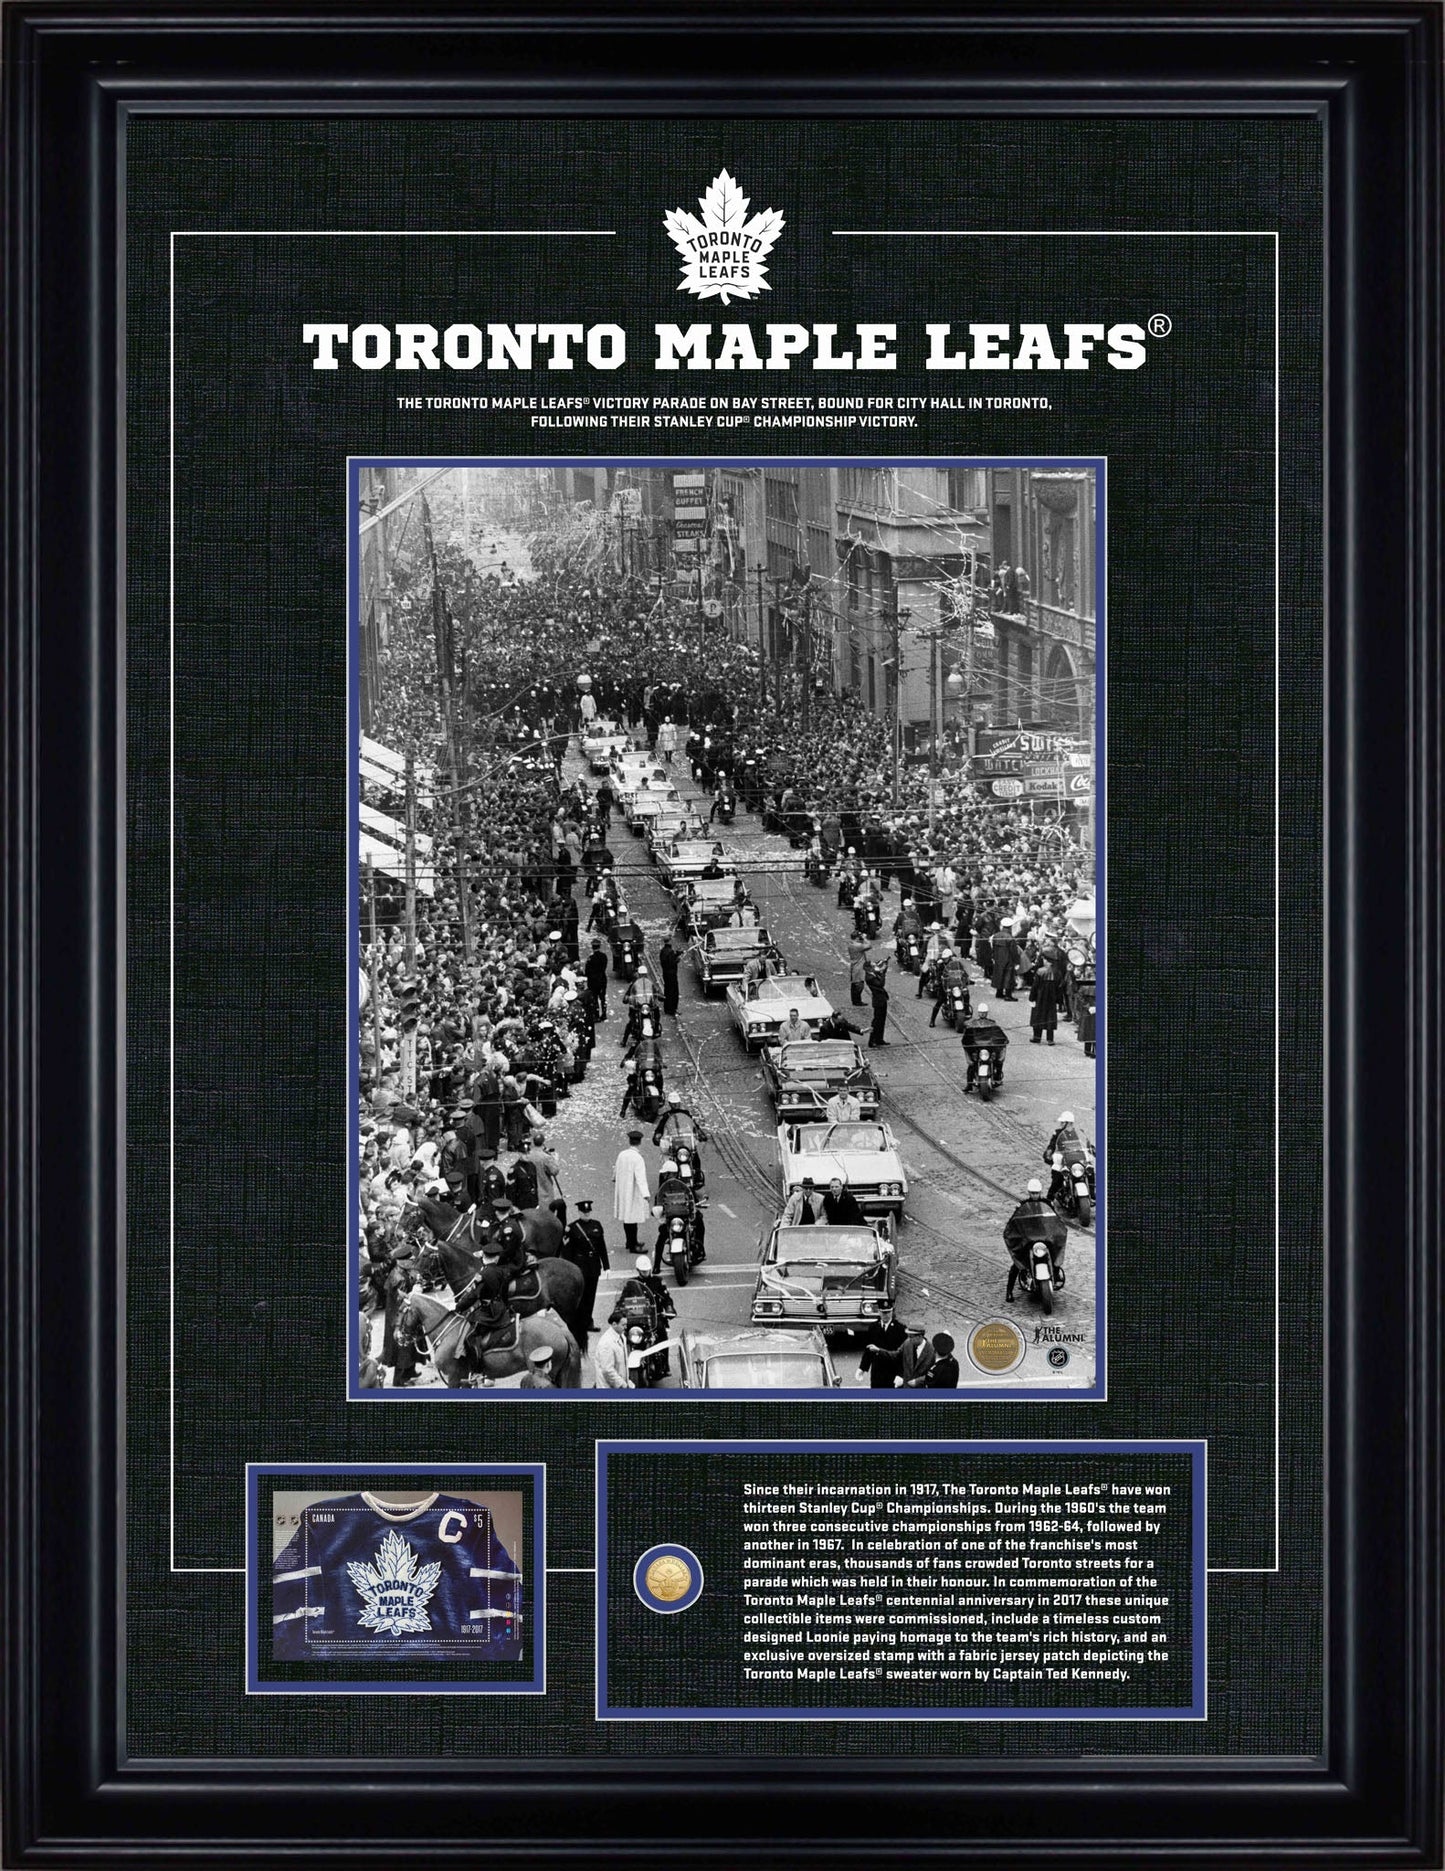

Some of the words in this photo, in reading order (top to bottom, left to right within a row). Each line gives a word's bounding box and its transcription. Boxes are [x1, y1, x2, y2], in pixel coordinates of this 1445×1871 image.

[686, 231, 763, 253] TORONTO
[699, 250, 750, 264] MAPLE
[699, 266, 750, 278] LEAFS
[302, 323, 626, 370] TORONTO
[654, 323, 897, 370] MAPLE
[396, 397, 423, 409] THE
[425, 397, 488, 409] TORONTO
[491, 397, 538, 409] MAPLE
[592, 397, 650, 409] VICTORY
[652, 397, 707, 409] PARADE
[710, 397, 729, 409] ON
[732, 397, 758, 409] BAY
[761, 397, 815, 411] STREET,
[818, 397, 864, 409] BOUND
[867, 397, 894, 409] FOR
[897, 397, 928, 409] CITY
[930, 397, 966, 409] HALL
[968, 397, 983, 409] IN
[985, 397, 1052, 411] TORONTO,
[531, 415, 608, 428] FOLLOWING
[610, 415, 650, 428] THEIR
[654, 415, 714, 428] STANLEY
[753, 415, 857, 428] CHAMPIONSHIP
[858, 415, 918, 428] VICTORY.
[1029, 782, 1058, 791] Kodak
[743, 1483, 780, 1495] Since
[782, 1483, 814, 1495] their
[817, 1483, 892, 1496] incarnation
[895, 1483, 907, 1495] in
[909, 1483, 940, 1497] 1917,
[941, 1483, 966, 1495] The
[968, 1483, 1019, 1495] Toronto
[1022, 1483, 1062, 1498] Maple
[1111, 1483, 1142, 1496] have
[1144, 1486, 1171, 1496] won
[743, 1501, 796, 1514] thirteen
[799, 1501, 848, 1517] Stanley
[886, 1501, 991, 1517] Championships.
[994, 1501, 1037, 1517] During
[1039, 1501, 1062, 1514] the
[1064, 1501, 1106, 1514] 1960's
[1108, 1501, 1130, 1514] the
[1132, 1502, 1167, 1514] team
[312, 1513, 335, 1524] CANADA
[473, 1514, 484, 1529] $5
[438, 1510, 468, 1544] C
[743, 1523, 770, 1532] won
[772, 1520, 807, 1532] three
[810, 1519, 889, 1532] consecutive
[892, 1519, 992, 1535] championships
[994, 1520, 1026, 1532] from
[1028, 1520, 1084, 1534] 1962-64,
[1086, 1520, 1142, 1532] followed
[1145, 1520, 1161, 1535] by
[743, 1538, 795, 1551] another
[797, 1538, 810, 1551] in
[812, 1538, 845, 1551] 1967.
[851, 1538, 864, 1551] In
[867, 1538, 941, 1551] celebration
[944, 1538, 959, 1551] of
[961, 1541, 985, 1551] one
[988, 1538, 1003, 1550] of
[1004, 1538, 1027, 1551] the
[1029, 1538, 1102, 1551] franchise's
[1104, 1539, 1138, 1551] most
[743, 1556, 806, 1569] dominant
[808, 1559, 841, 1571] eras,
[843, 1557, 913, 1569] thousands
[916, 1557, 931, 1569] of
[932, 1556, 962, 1569] fans
[964, 1557, 1019, 1569] crowded
[1021, 1557, 1072, 1569] Toronto
[1075, 1558, 1122, 1569] streets
[1124, 1556, 1144, 1569] for
[1146, 1559, 1154, 1569] a
[367, 1580, 425, 1596] TORONTO
[743, 1575, 789, 1590] parade
[791, 1575, 829, 1588] which
[831, 1578, 857, 1588] was
[860, 1575, 888, 1588] held
[891, 1575, 904, 1588] in
[906, 1575, 938, 1588] their
[940, 1575, 990, 1588] honour.
[993, 1575, 1006, 1588] In
[1009, 1575, 1116, 1588] commemoration
[1119, 1575, 1134, 1588] of
[1135, 1575, 1158, 1588] the
[378, 1596, 414, 1607] MAPLE
[743, 1593, 794, 1606] Toronto
[796, 1594, 836, 1609] Maple
[886, 1593, 955, 1606] centennial
[958, 1593, 1035, 1609] anniversary
[1037, 1593, 1050, 1606] in
[1053, 1593, 1083, 1606] 2017
[1084, 1593, 1122, 1606] these
[1124, 1593, 1169, 1609] unique
[377, 1606, 417, 1618] LEAFS
[743, 1612, 812, 1624] collectible
[815, 1612, 852, 1625] items
[854, 1615, 886, 1625] were
[888, 1612, 988, 1626] commissioned,
[991, 1612, 1039, 1625] include
[1042, 1615, 1050, 1625] a
[1052, 1612, 1110, 1625] timeless
[1112, 1613, 1162, 1625] custom
[460, 1624, 484, 1634] 1917-2017
[743, 1630, 803, 1646] designed
[806, 1630, 850, 1643] Loonie
[853, 1630, 897, 1646] paying
[899, 1630, 952, 1646] homage
[954, 1632, 969, 1643] to
[970, 1630, 993, 1643] the
[995, 1631, 1040, 1643] team's
[1043, 1630, 1068, 1643] rich
[1071, 1630, 1120, 1646] history,
[1123, 1630, 1148, 1643] and
[1151, 1633, 1167, 1643] an
[743, 1649, 805, 1661] exclusive
[807, 1649, 871, 1661] oversized
[873, 1650, 915, 1664] stamp
[917, 1649, 945, 1661] with
[948, 1652, 956, 1661] a
[958, 1649, 998, 1661] fabric
[999, 1649, 1040, 1664] jersey
[1043, 1649, 1080, 1664] patch
[1083, 1649, 1145, 1664] depicting
[1147, 1649, 1169, 1661] the
[743, 1667, 794, 1680] Toronto
[797, 1667, 836, 1683] Maple
[886, 1668, 938, 1680] sweater
[939, 1670, 971, 1680] worn
[974, 1667, 990, 1683] by
[993, 1667, 1043, 1683] Captain
[1045, 1667, 1068, 1680] Ted
[1071, 1667, 1131, 1683] Kennedy.
